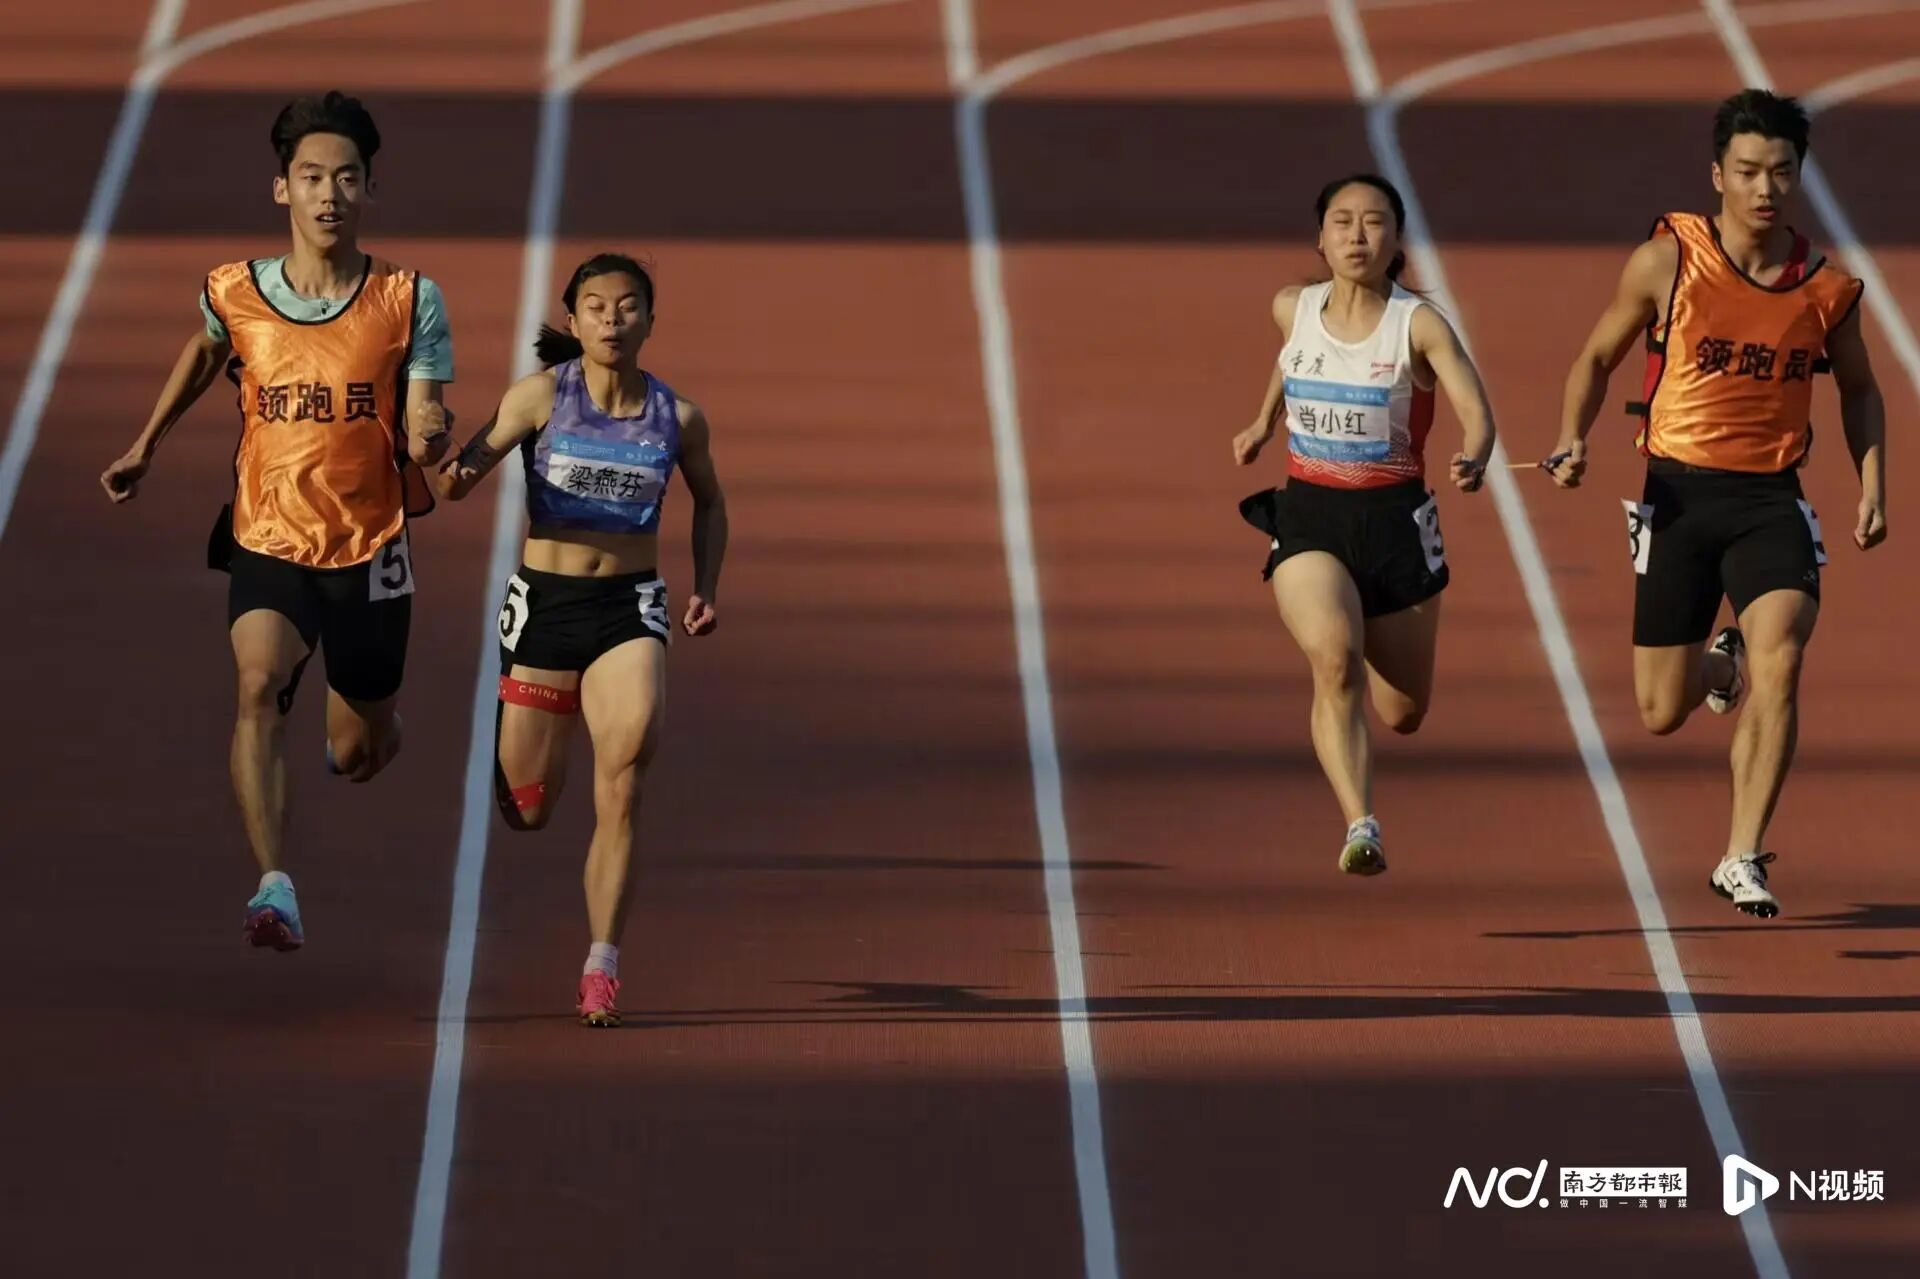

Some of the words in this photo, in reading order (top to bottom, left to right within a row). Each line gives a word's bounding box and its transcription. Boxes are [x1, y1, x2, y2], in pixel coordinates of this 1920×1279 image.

[1696, 336, 1809, 383] 领跑员
[257, 381, 377, 424] 领跑员
[1299, 405, 1367, 436] 肖小红
[568, 464, 645, 498] 梁燕芬
[380, 536, 407, 590] 5
[500, 583, 522, 638] 5
[518, 684, 559, 702] CHINA
